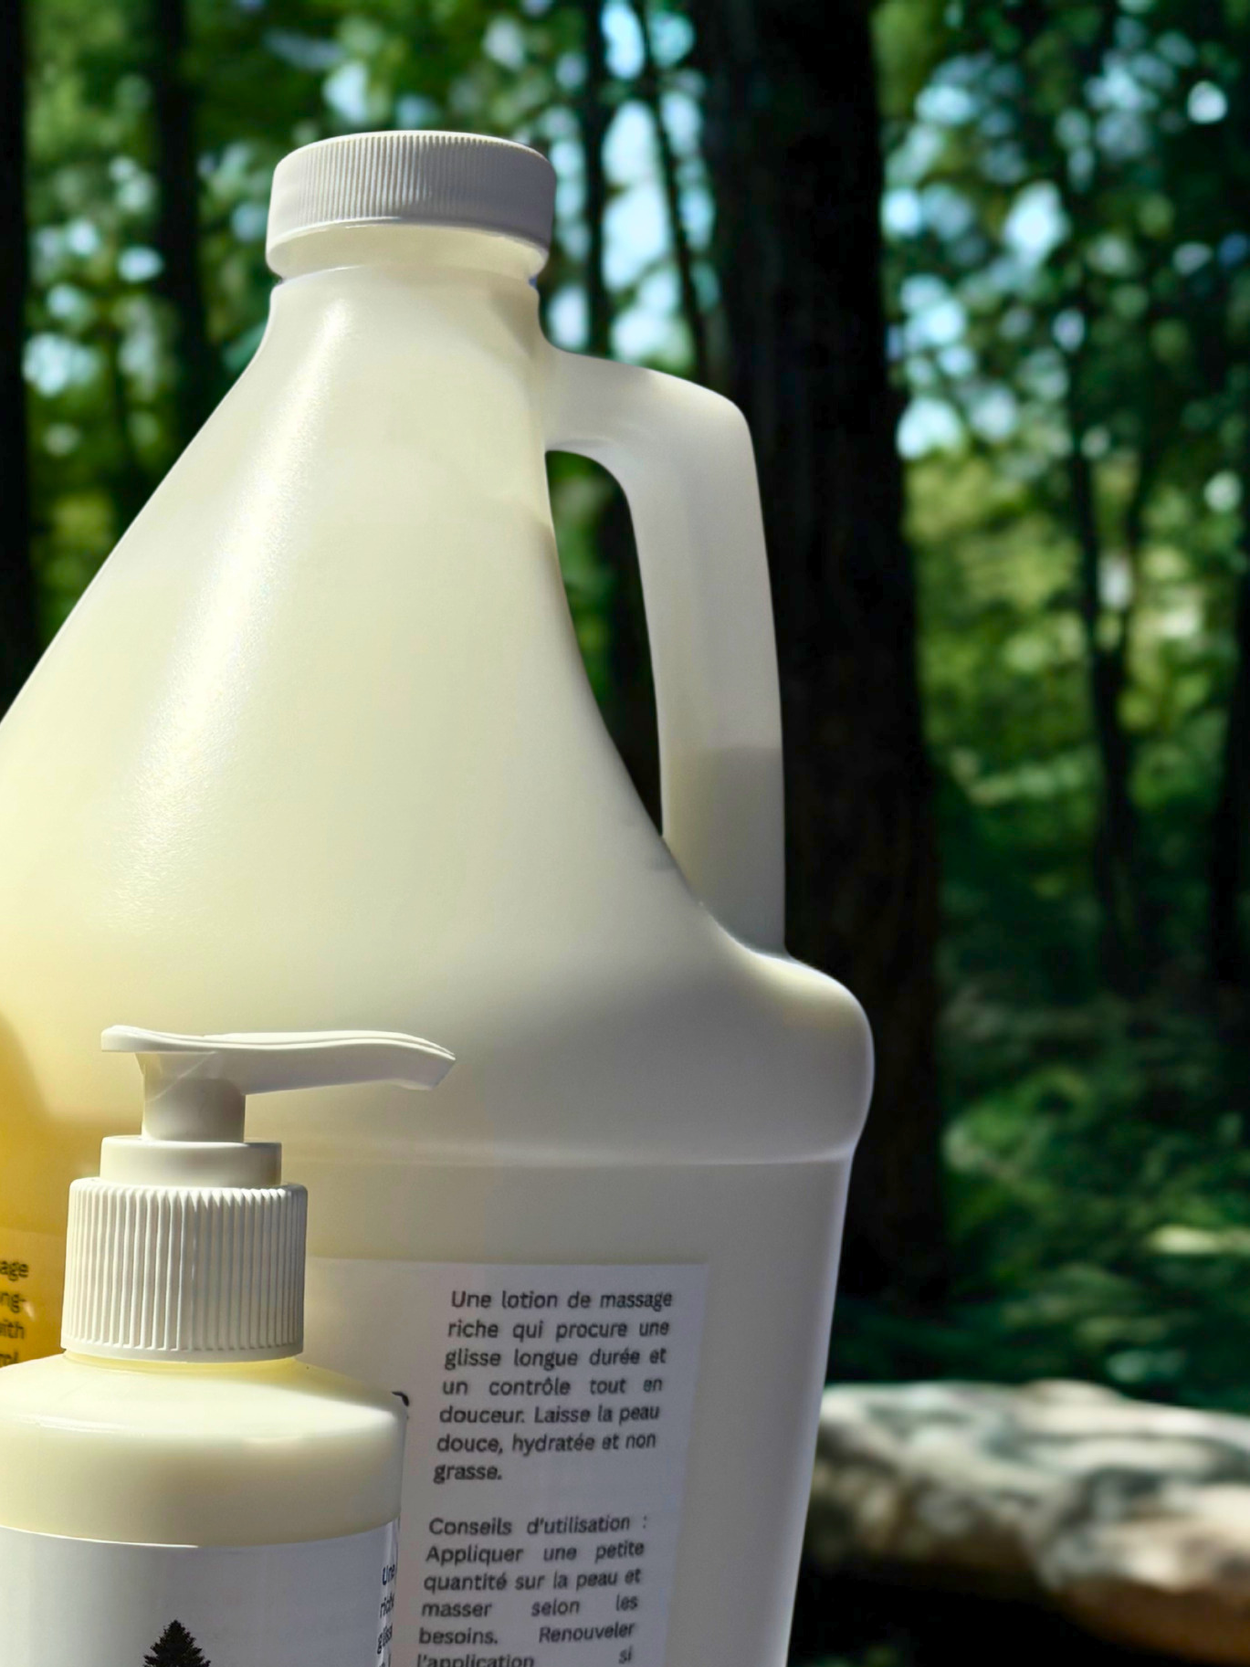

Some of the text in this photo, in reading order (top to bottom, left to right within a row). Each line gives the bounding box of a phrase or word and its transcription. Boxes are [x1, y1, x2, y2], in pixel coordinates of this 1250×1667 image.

[452, 1290, 673, 1312] Une lotion de massage
[448, 1320, 670, 1342] riche qui procure une
[444, 1348, 666, 1370] glisse longue durée et
[443, 1378, 662, 1396] un contrôle tout en
[440, 1406, 660, 1425] douceur. Laisse la peau
[437, 1433, 656, 1456] douce, hydratée et non
[433, 1464, 502, 1484] grasse.
[429, 1517, 512, 1536] Conseils
[527, 1515, 630, 1534] d'utilisation
